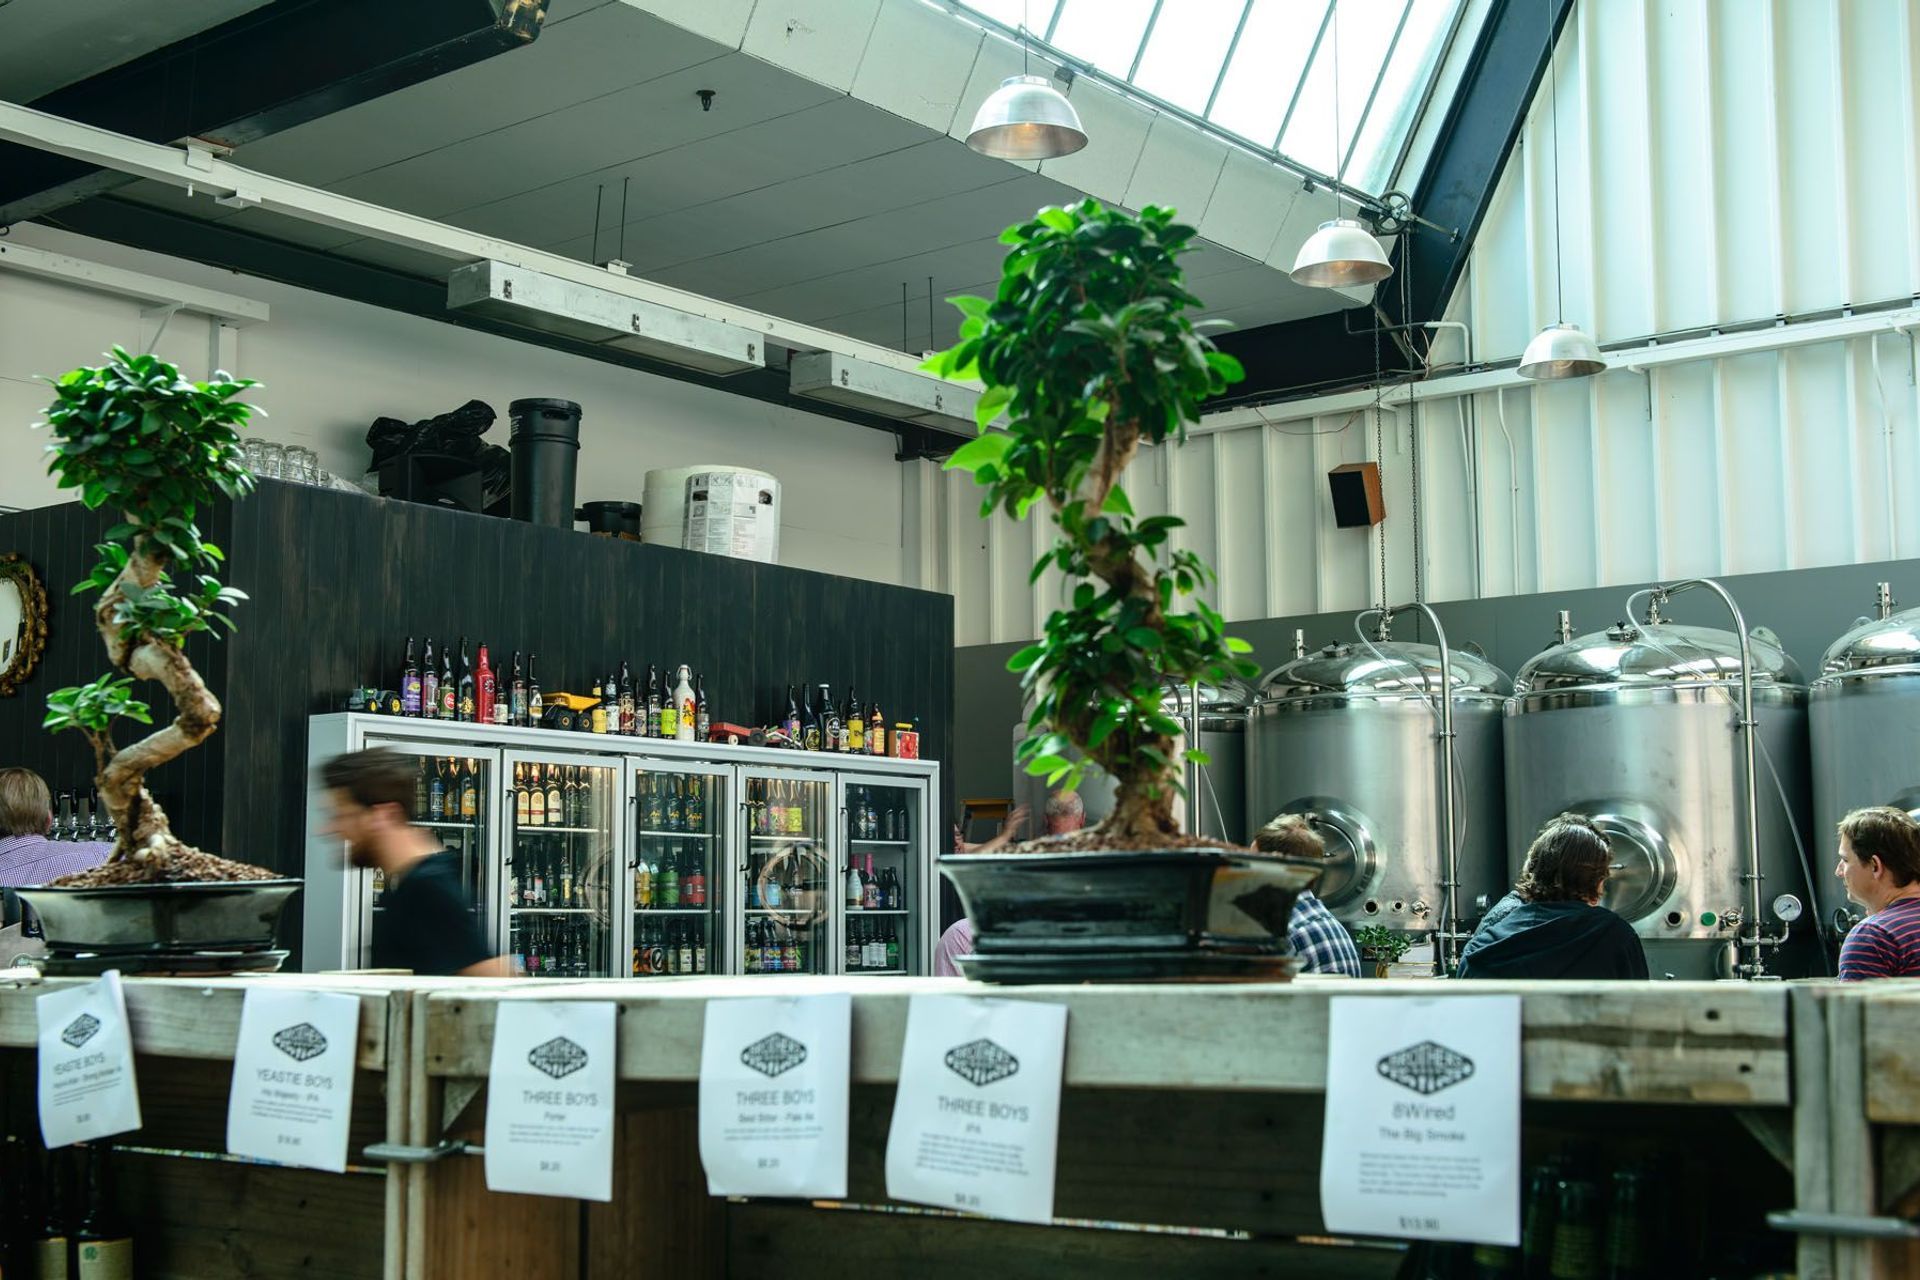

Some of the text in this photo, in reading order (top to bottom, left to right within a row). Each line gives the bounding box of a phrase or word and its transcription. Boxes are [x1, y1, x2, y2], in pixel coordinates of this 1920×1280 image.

[256, 1068, 335, 1090] YEASTIE BOYS
[522, 1090, 598, 1107] THREE BOYS
[737, 1087, 815, 1106] THREE BOYS
[937, 1095, 1029, 1123] THREE BOYS
[1379, 1126, 1466, 1144] The Big Smoke
